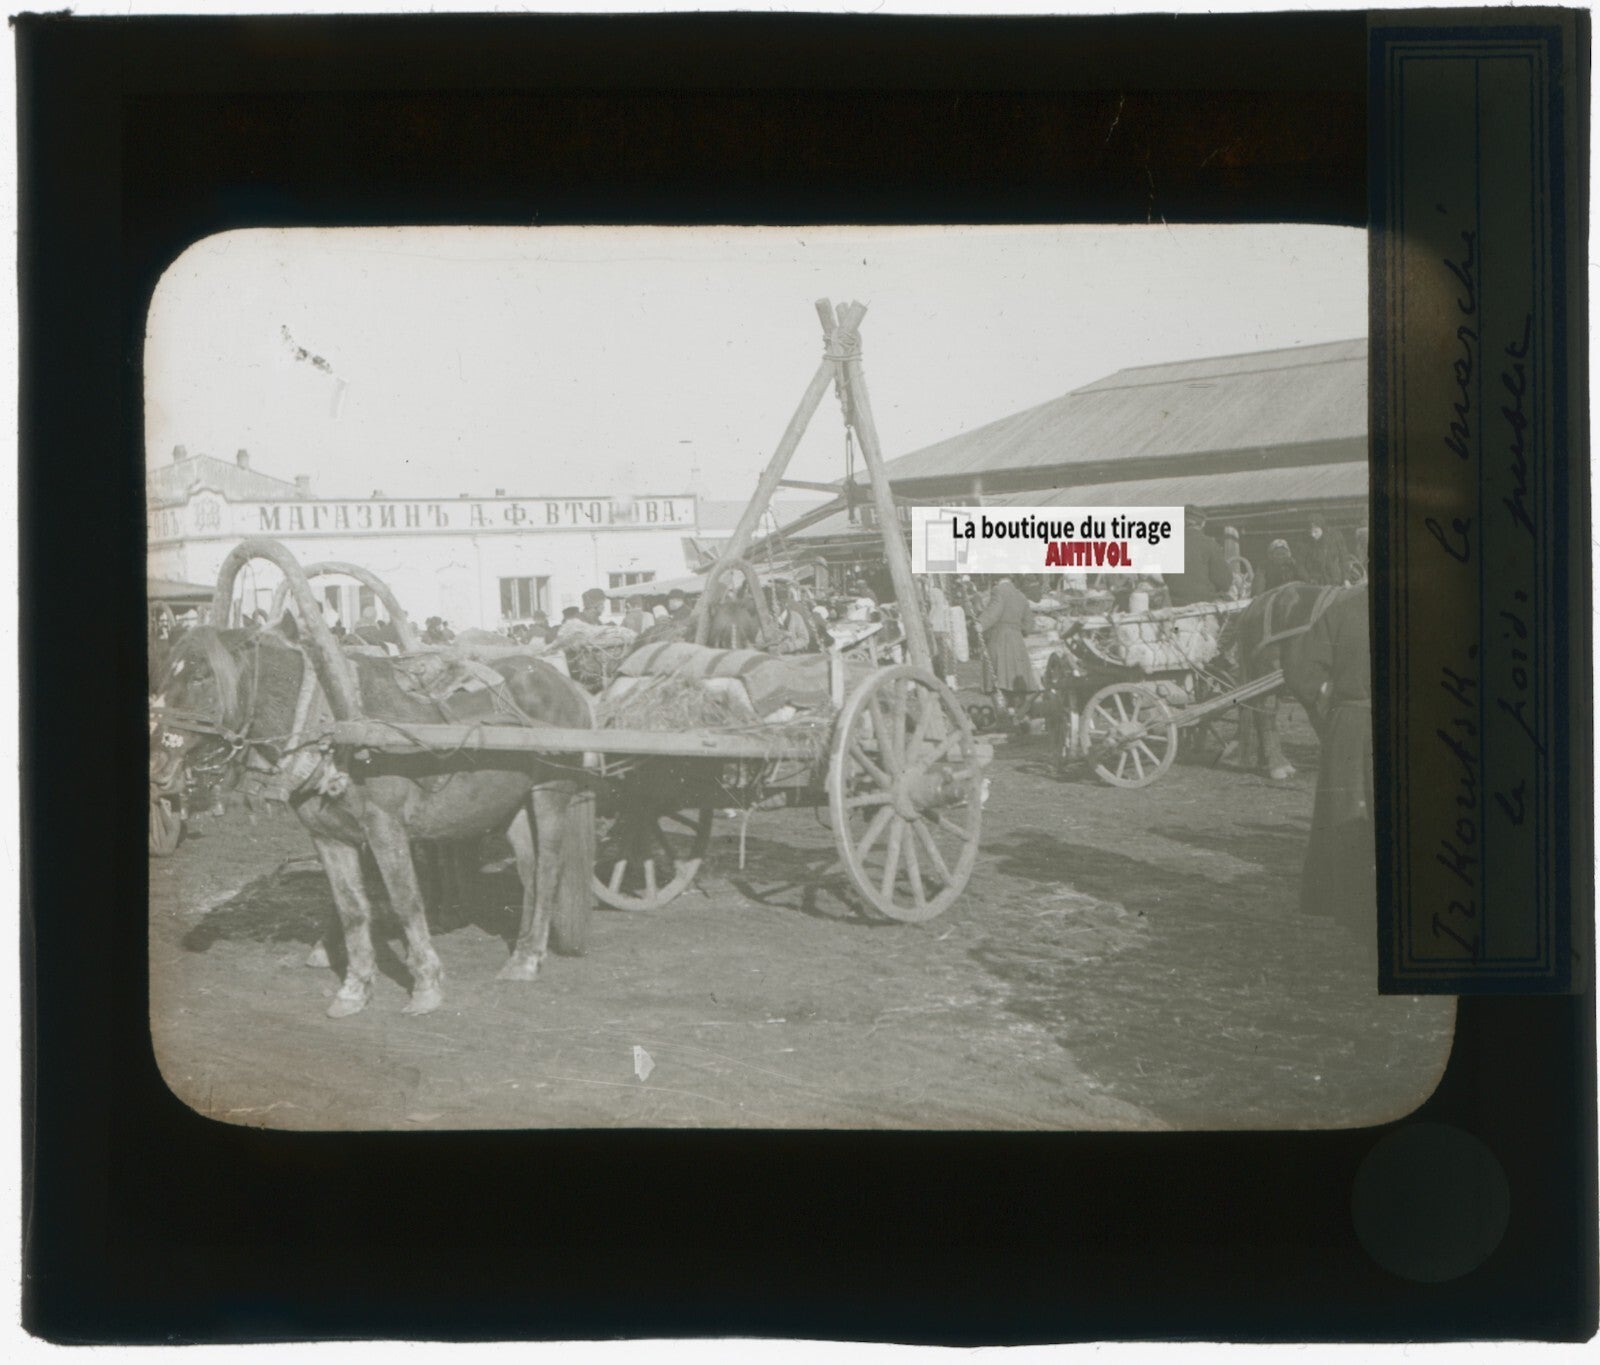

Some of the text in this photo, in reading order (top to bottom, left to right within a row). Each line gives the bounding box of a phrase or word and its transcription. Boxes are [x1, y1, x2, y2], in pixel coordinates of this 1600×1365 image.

[1435, 202, 1478, 460] marché
[1500, 314, 1536, 540] public
[259, 503, 449, 531] МАГАЗИНЪ
[470, 503, 493, 527] А.
[503, 502, 534, 526] Ф.
